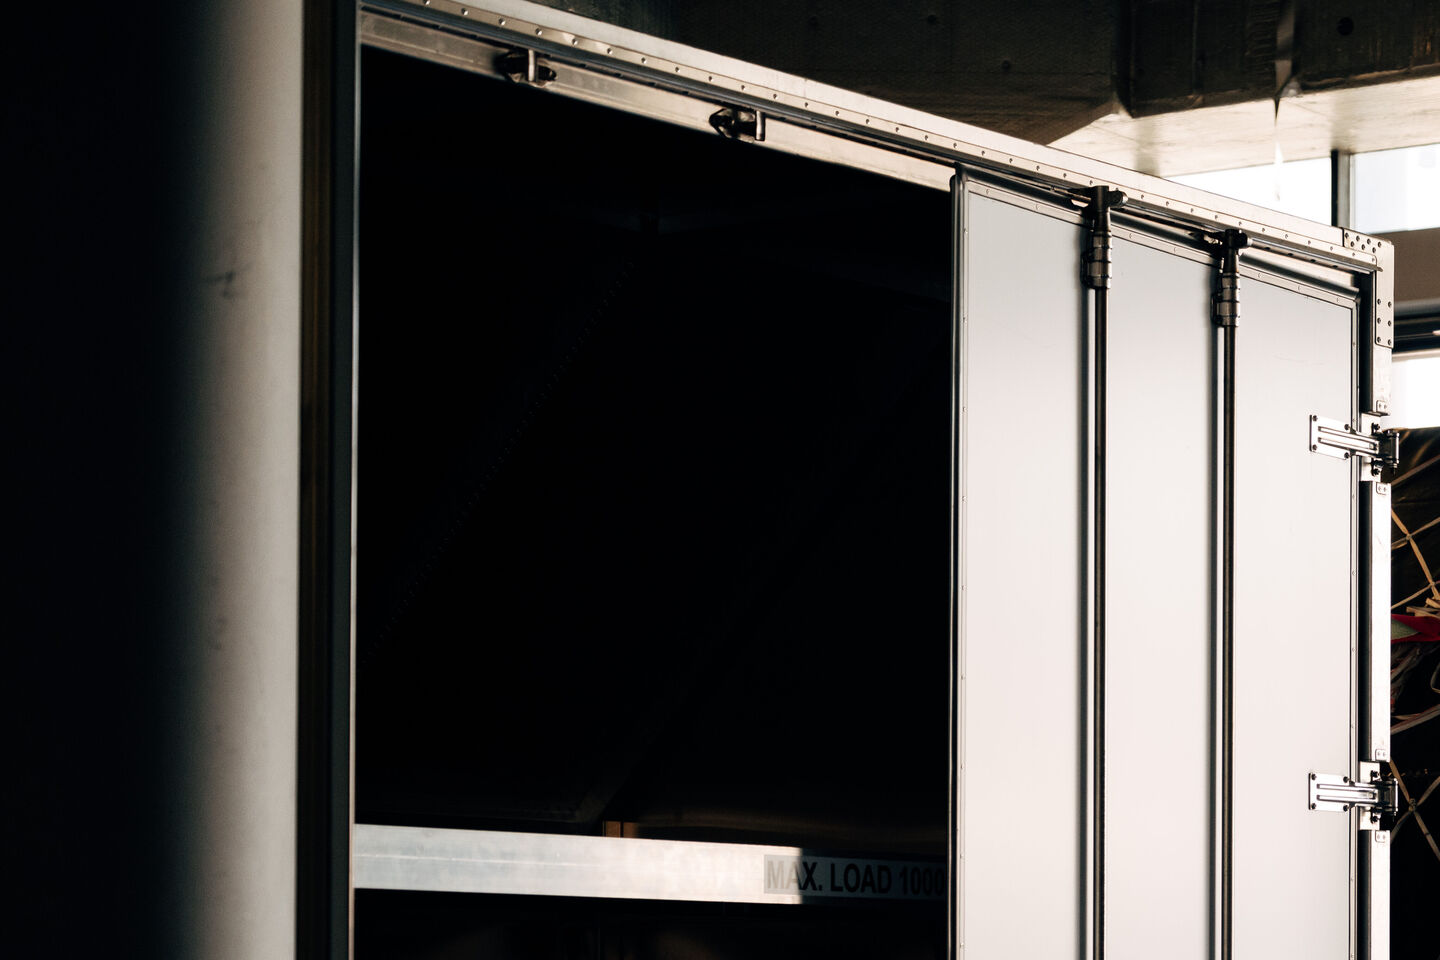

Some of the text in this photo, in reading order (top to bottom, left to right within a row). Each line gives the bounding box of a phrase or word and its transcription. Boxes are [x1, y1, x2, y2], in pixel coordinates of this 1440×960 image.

[767, 860, 945, 896] MAX. LOAD 1000
